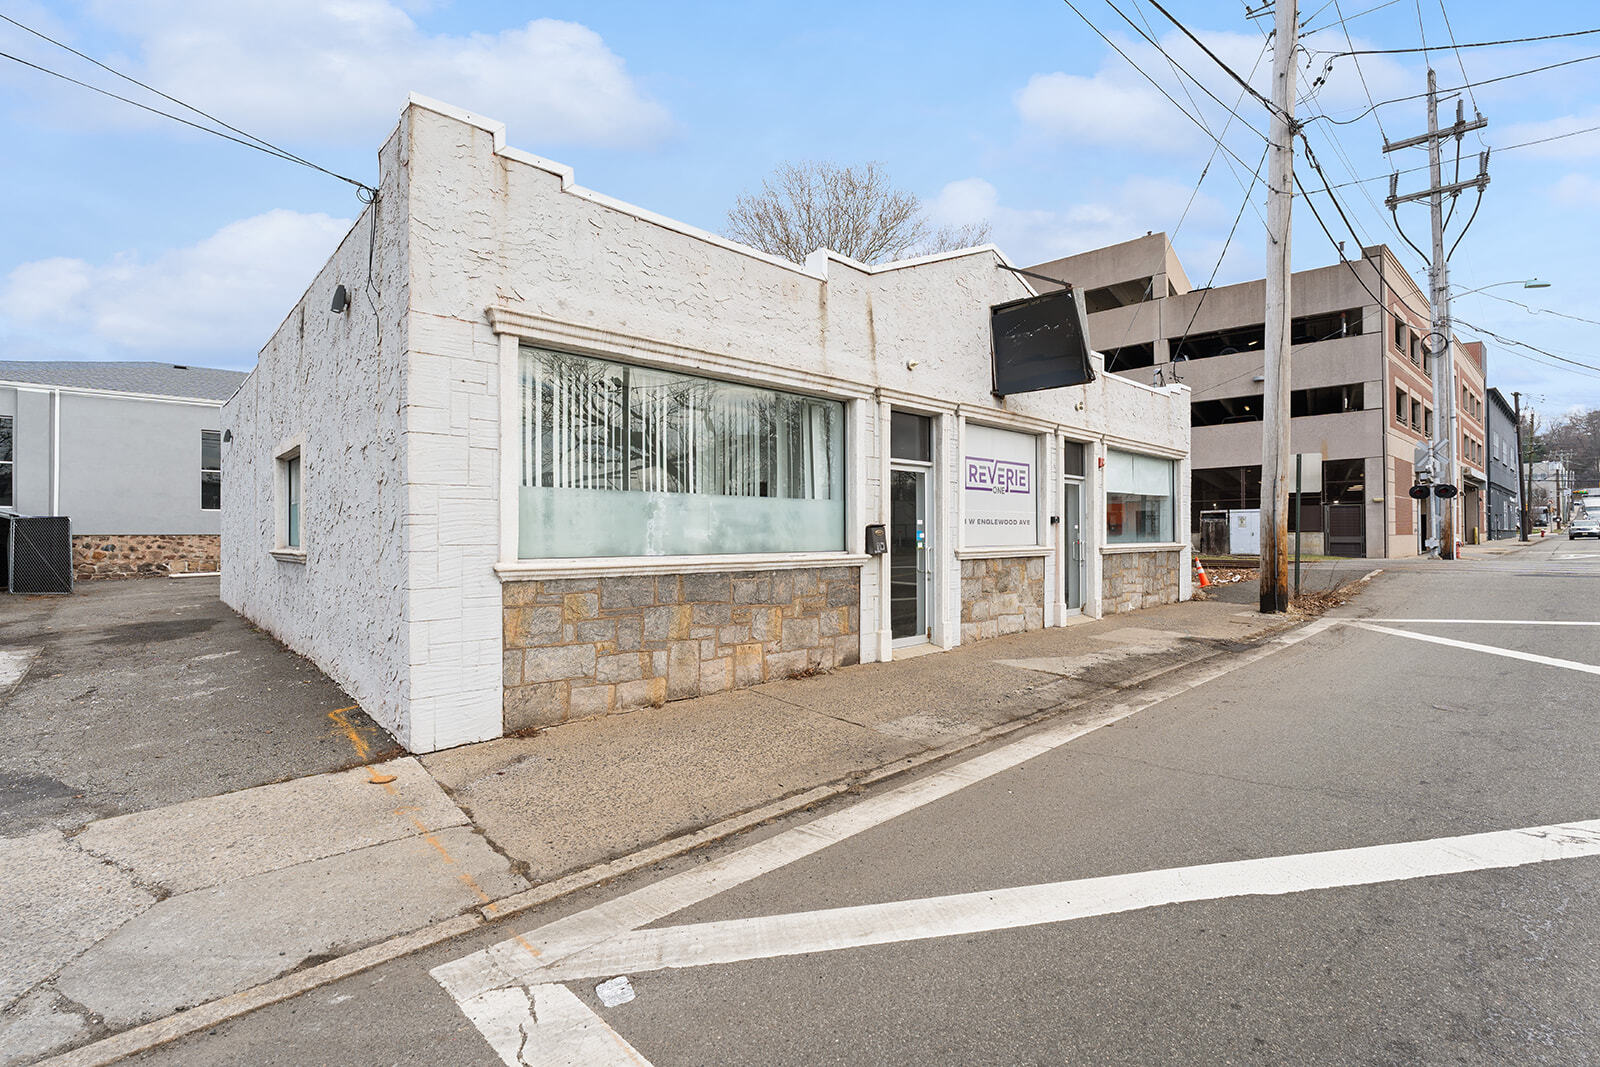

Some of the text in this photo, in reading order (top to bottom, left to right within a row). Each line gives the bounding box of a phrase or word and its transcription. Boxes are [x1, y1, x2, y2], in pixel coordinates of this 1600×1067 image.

[968, 462, 1026, 491] REVERIE
[992, 486, 1005, 495] ONE
[976, 518, 1018, 526] ENGLEWOOD
